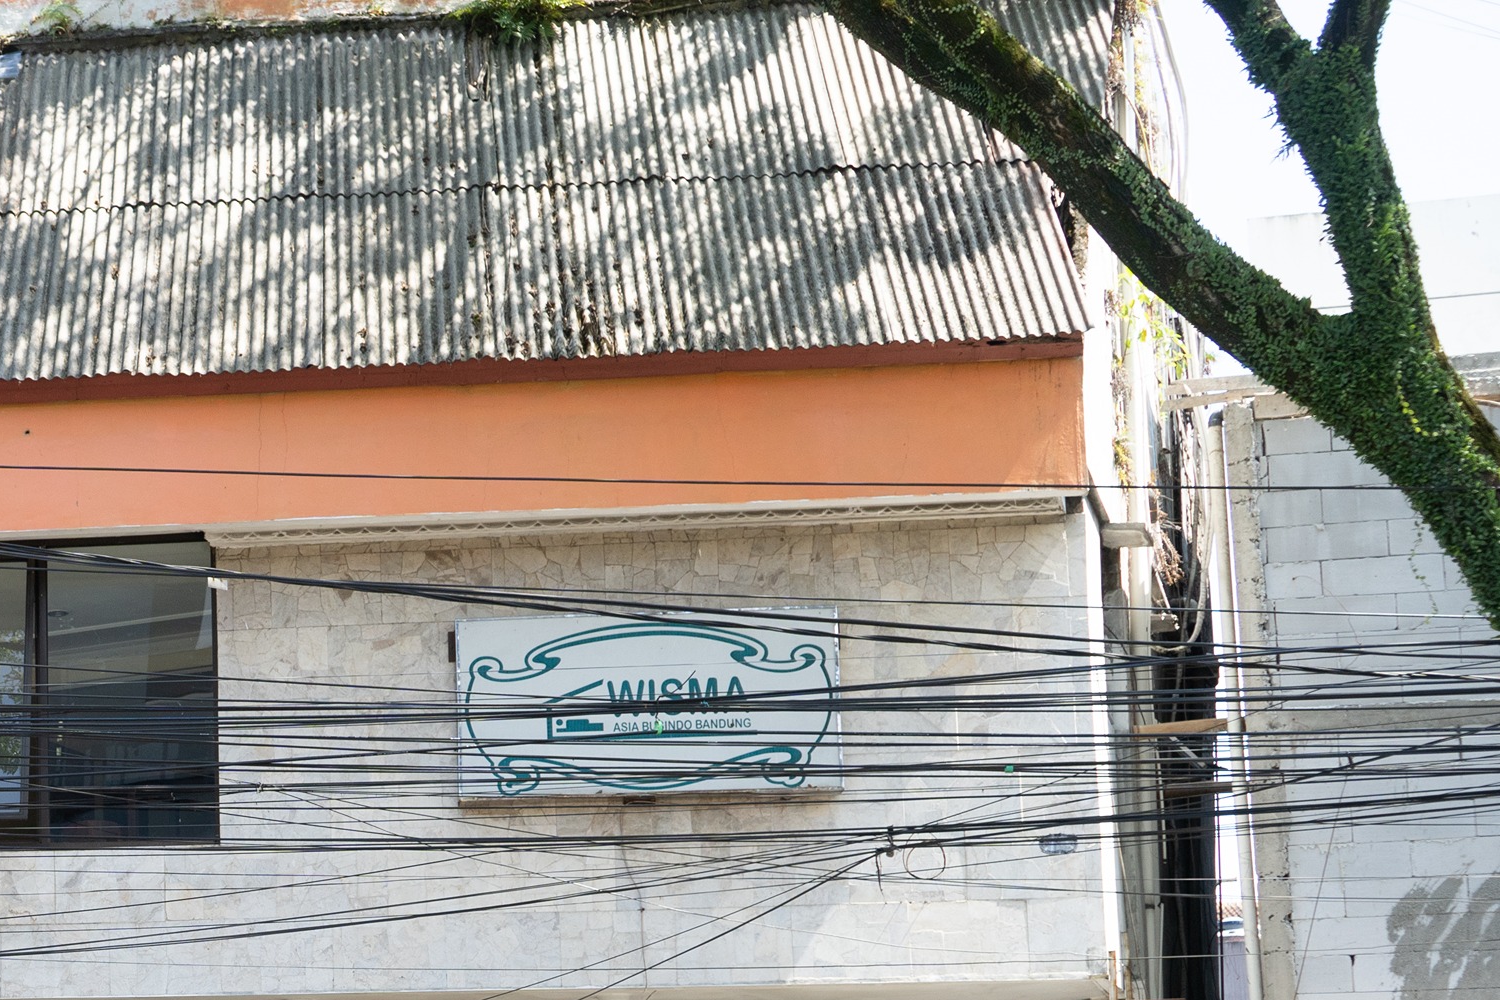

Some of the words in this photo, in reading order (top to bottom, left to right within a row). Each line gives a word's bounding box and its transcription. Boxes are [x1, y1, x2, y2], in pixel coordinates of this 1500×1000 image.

[613, 721, 639, 732] ASIA
[642, 719, 692, 732] BUINDO
[695, 718, 751, 730] BANDUNG
